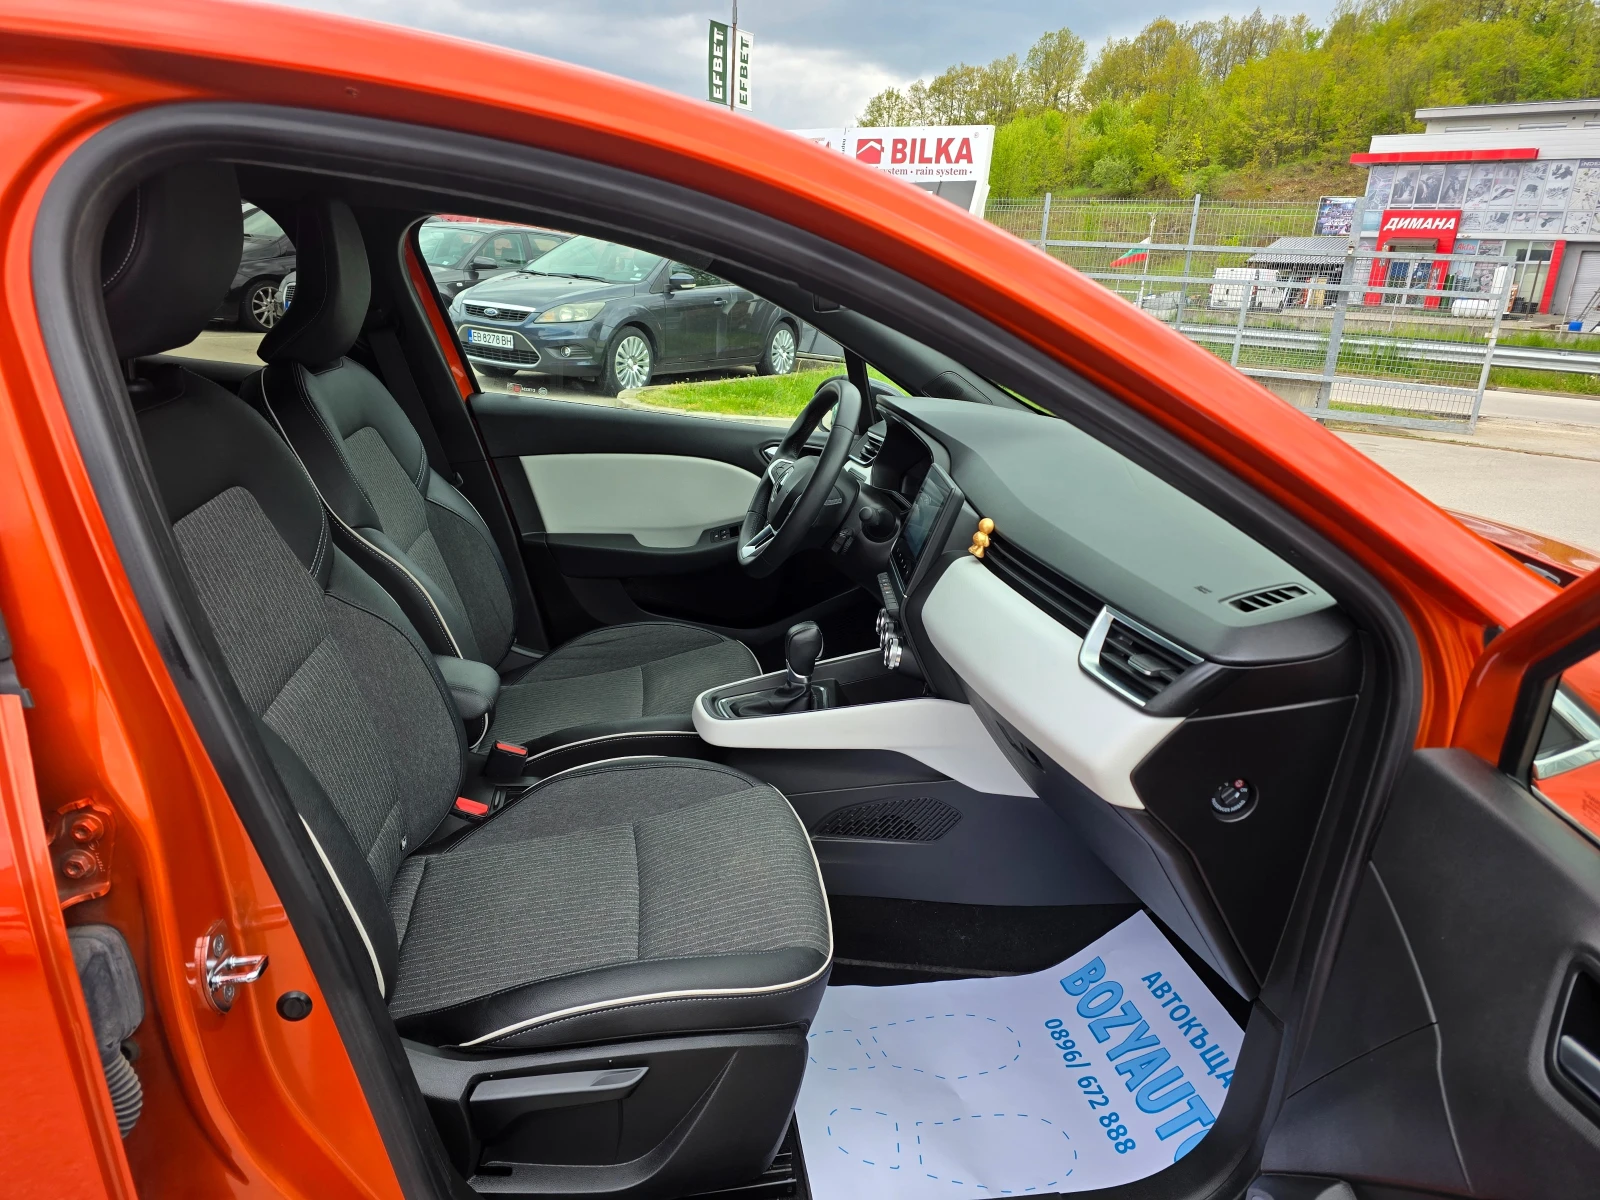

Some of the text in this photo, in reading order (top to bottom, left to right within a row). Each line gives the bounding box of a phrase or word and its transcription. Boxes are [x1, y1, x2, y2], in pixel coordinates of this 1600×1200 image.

[712, 26, 724, 100] EFBET
[739, 35, 750, 106] EFBET
[890, 137, 974, 165] BILKA
[915, 166, 934, 176] rain
[935, 166, 968, 178] system
[1382, 217, 1457, 231] ДИМАНА
[1044, 1018, 1136, 1154] 0896/ 672 888
